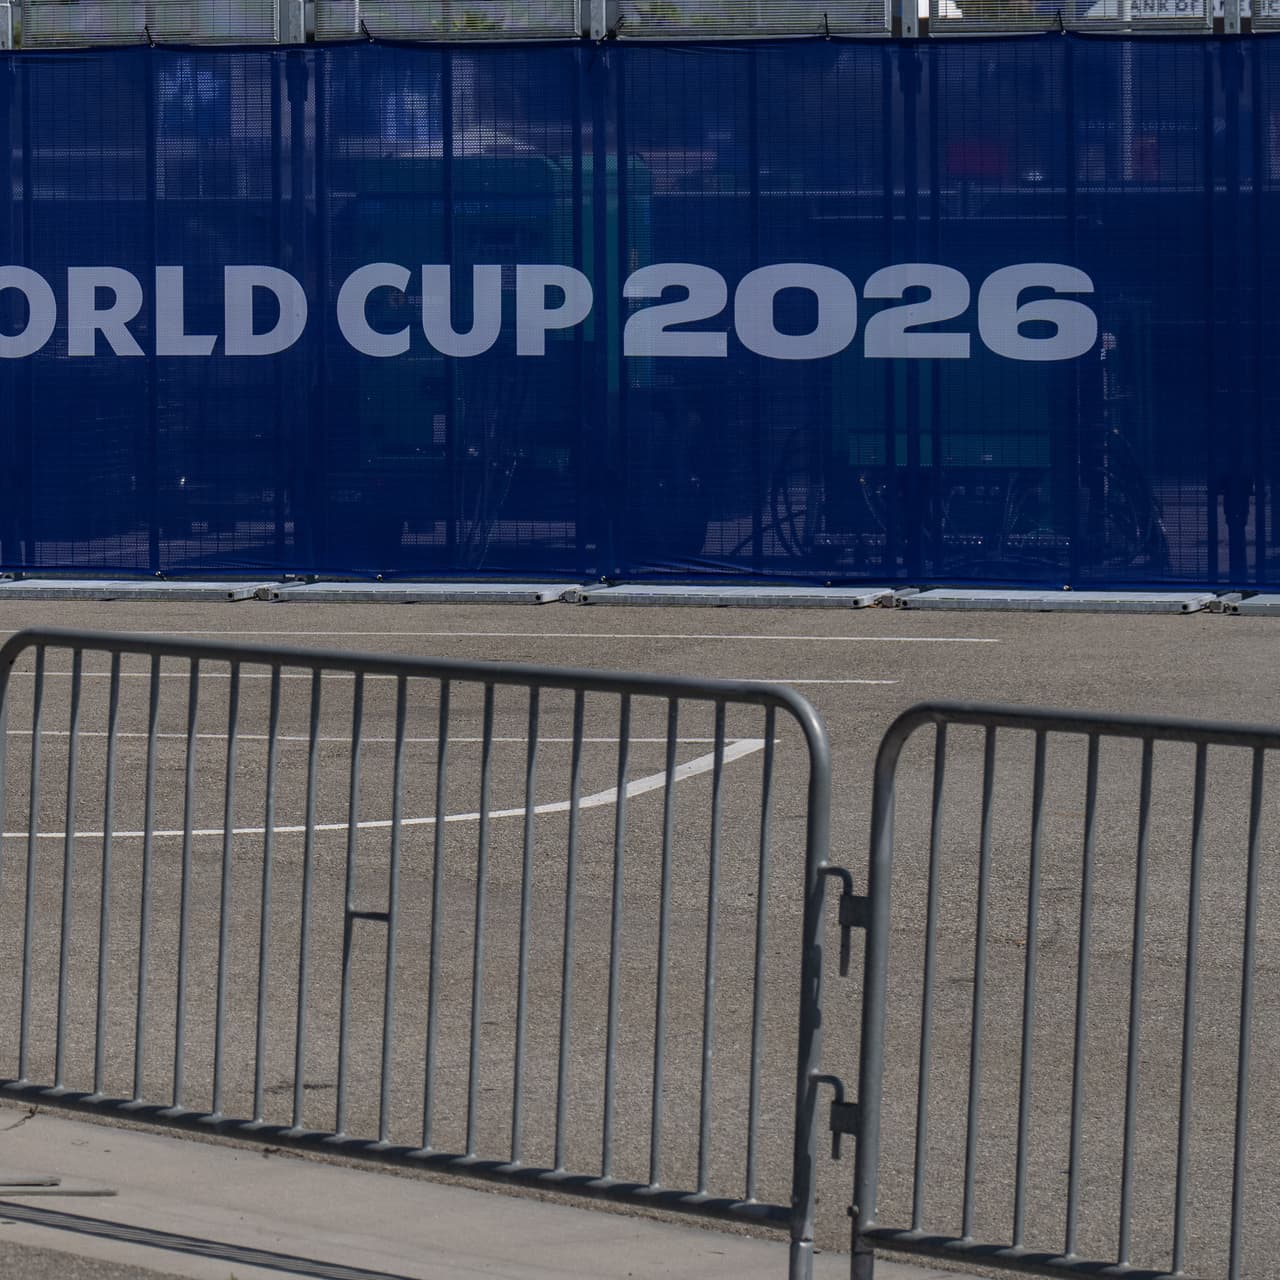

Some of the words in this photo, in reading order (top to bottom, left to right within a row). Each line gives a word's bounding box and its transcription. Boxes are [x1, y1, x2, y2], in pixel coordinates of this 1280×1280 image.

[1128, 0, 1168, 13] ANK
[336, 262, 593, 358] CUP
[623, 262, 1098, 361] 2026
